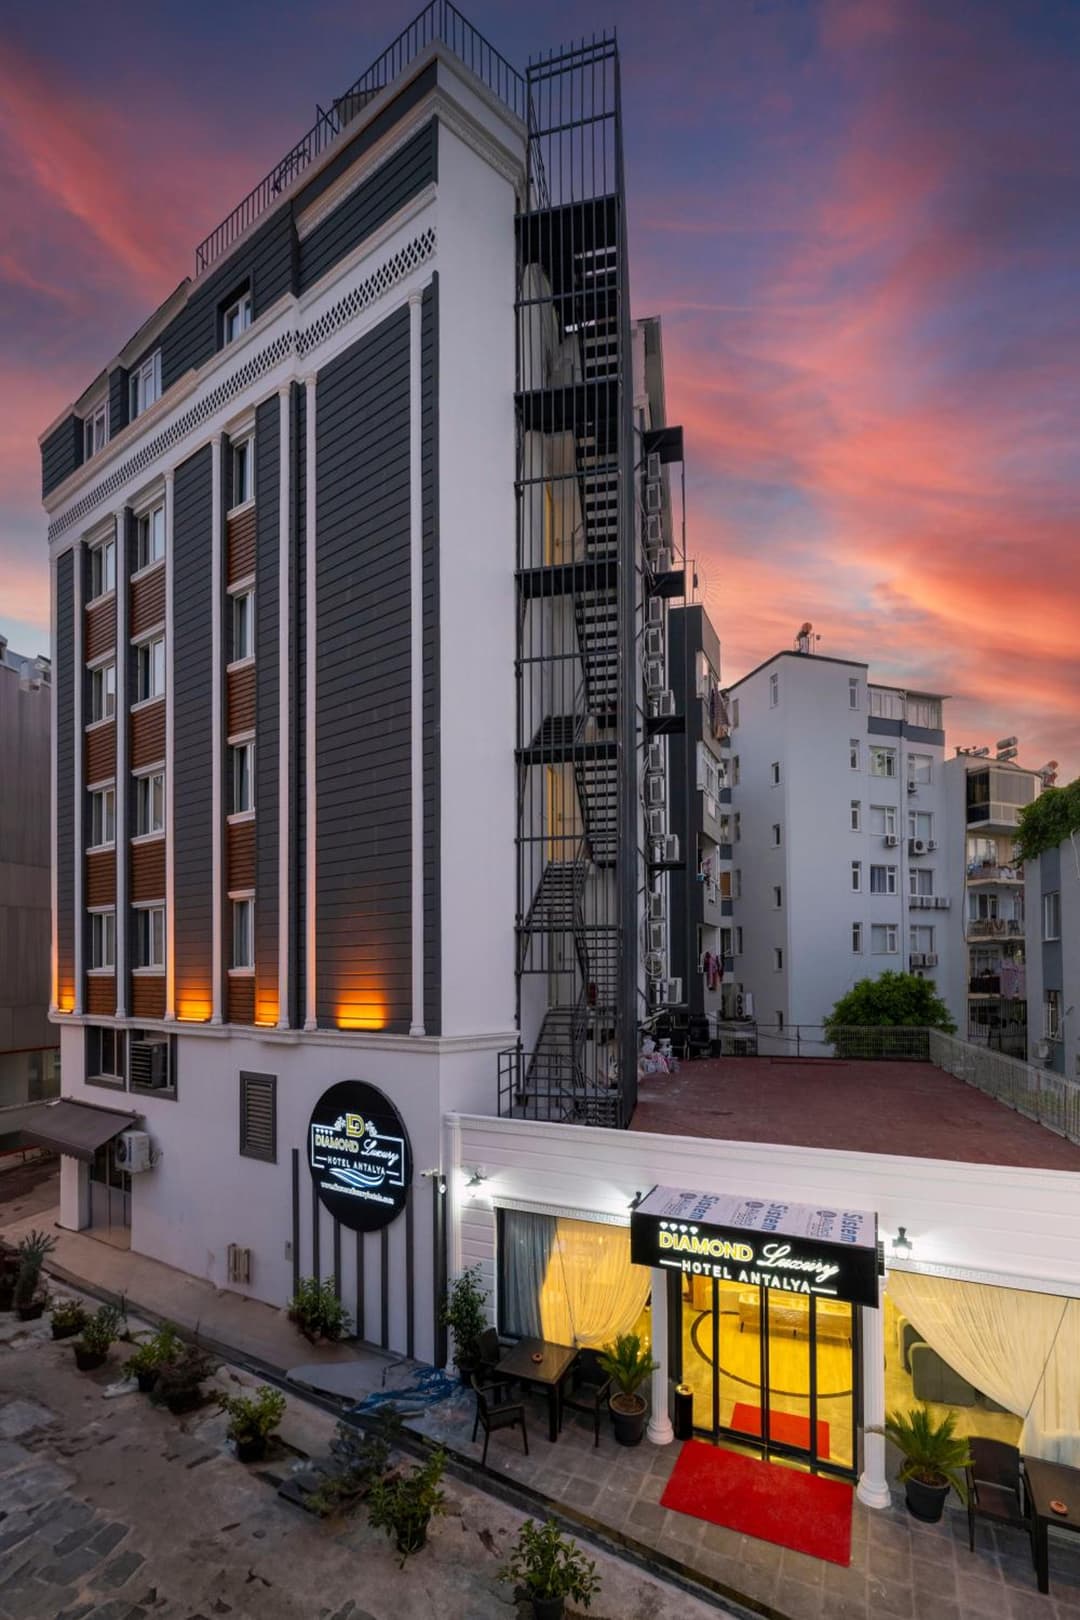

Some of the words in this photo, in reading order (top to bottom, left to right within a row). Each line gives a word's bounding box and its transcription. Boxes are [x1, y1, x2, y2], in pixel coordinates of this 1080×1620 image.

[315, 1134, 359, 1153] DIAMOND
[361, 1139, 399, 1166] Luxury
[327, 1155, 350, 1168] HOTEL
[353, 1161, 386, 1175] ANTALYA
[688, 1194, 720, 1220] Sistem
[761, 1203, 789, 1231] Sistem
[840, 1212, 863, 1243] Sistem
[659, 1231, 754, 1262] DIAMOND
[756, 1243, 840, 1283] Luxury
[681, 1259, 732, 1280] HOTEL
[738, 1269, 812, 1294] ANTALYA
